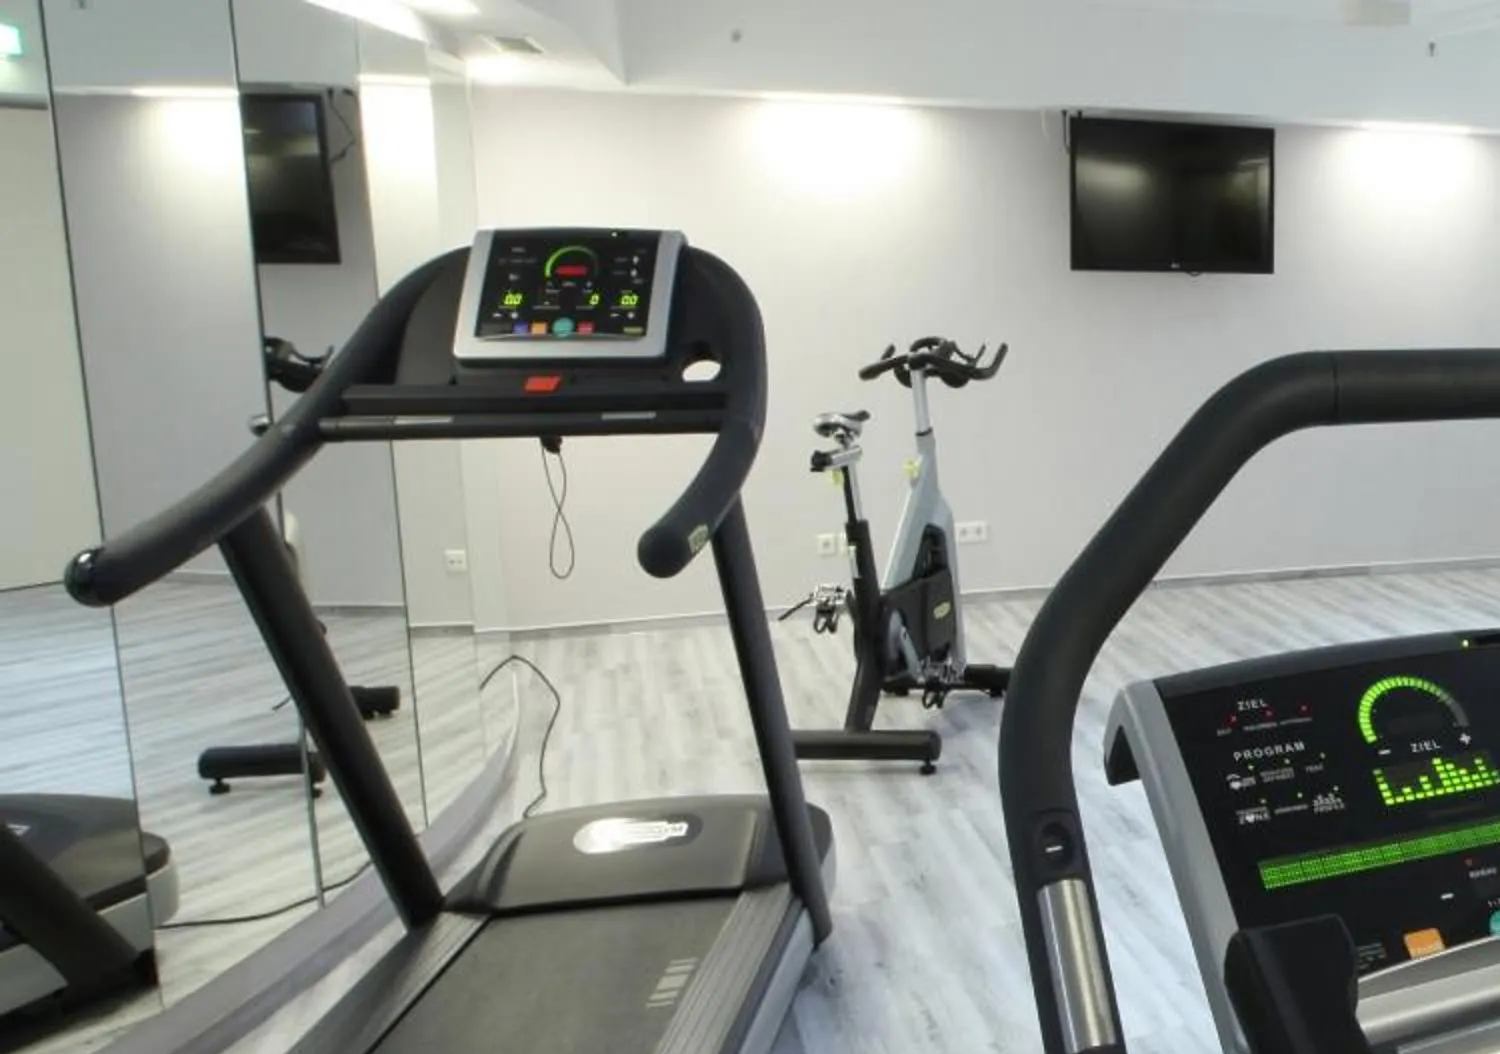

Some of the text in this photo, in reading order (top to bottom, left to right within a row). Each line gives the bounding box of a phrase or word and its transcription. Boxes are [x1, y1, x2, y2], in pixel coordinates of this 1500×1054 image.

[1236, 698, 1268, 711] ZIEL
[1233, 740, 1306, 761] PROGRAM
[1410, 738, 1441, 753] ZIEL
